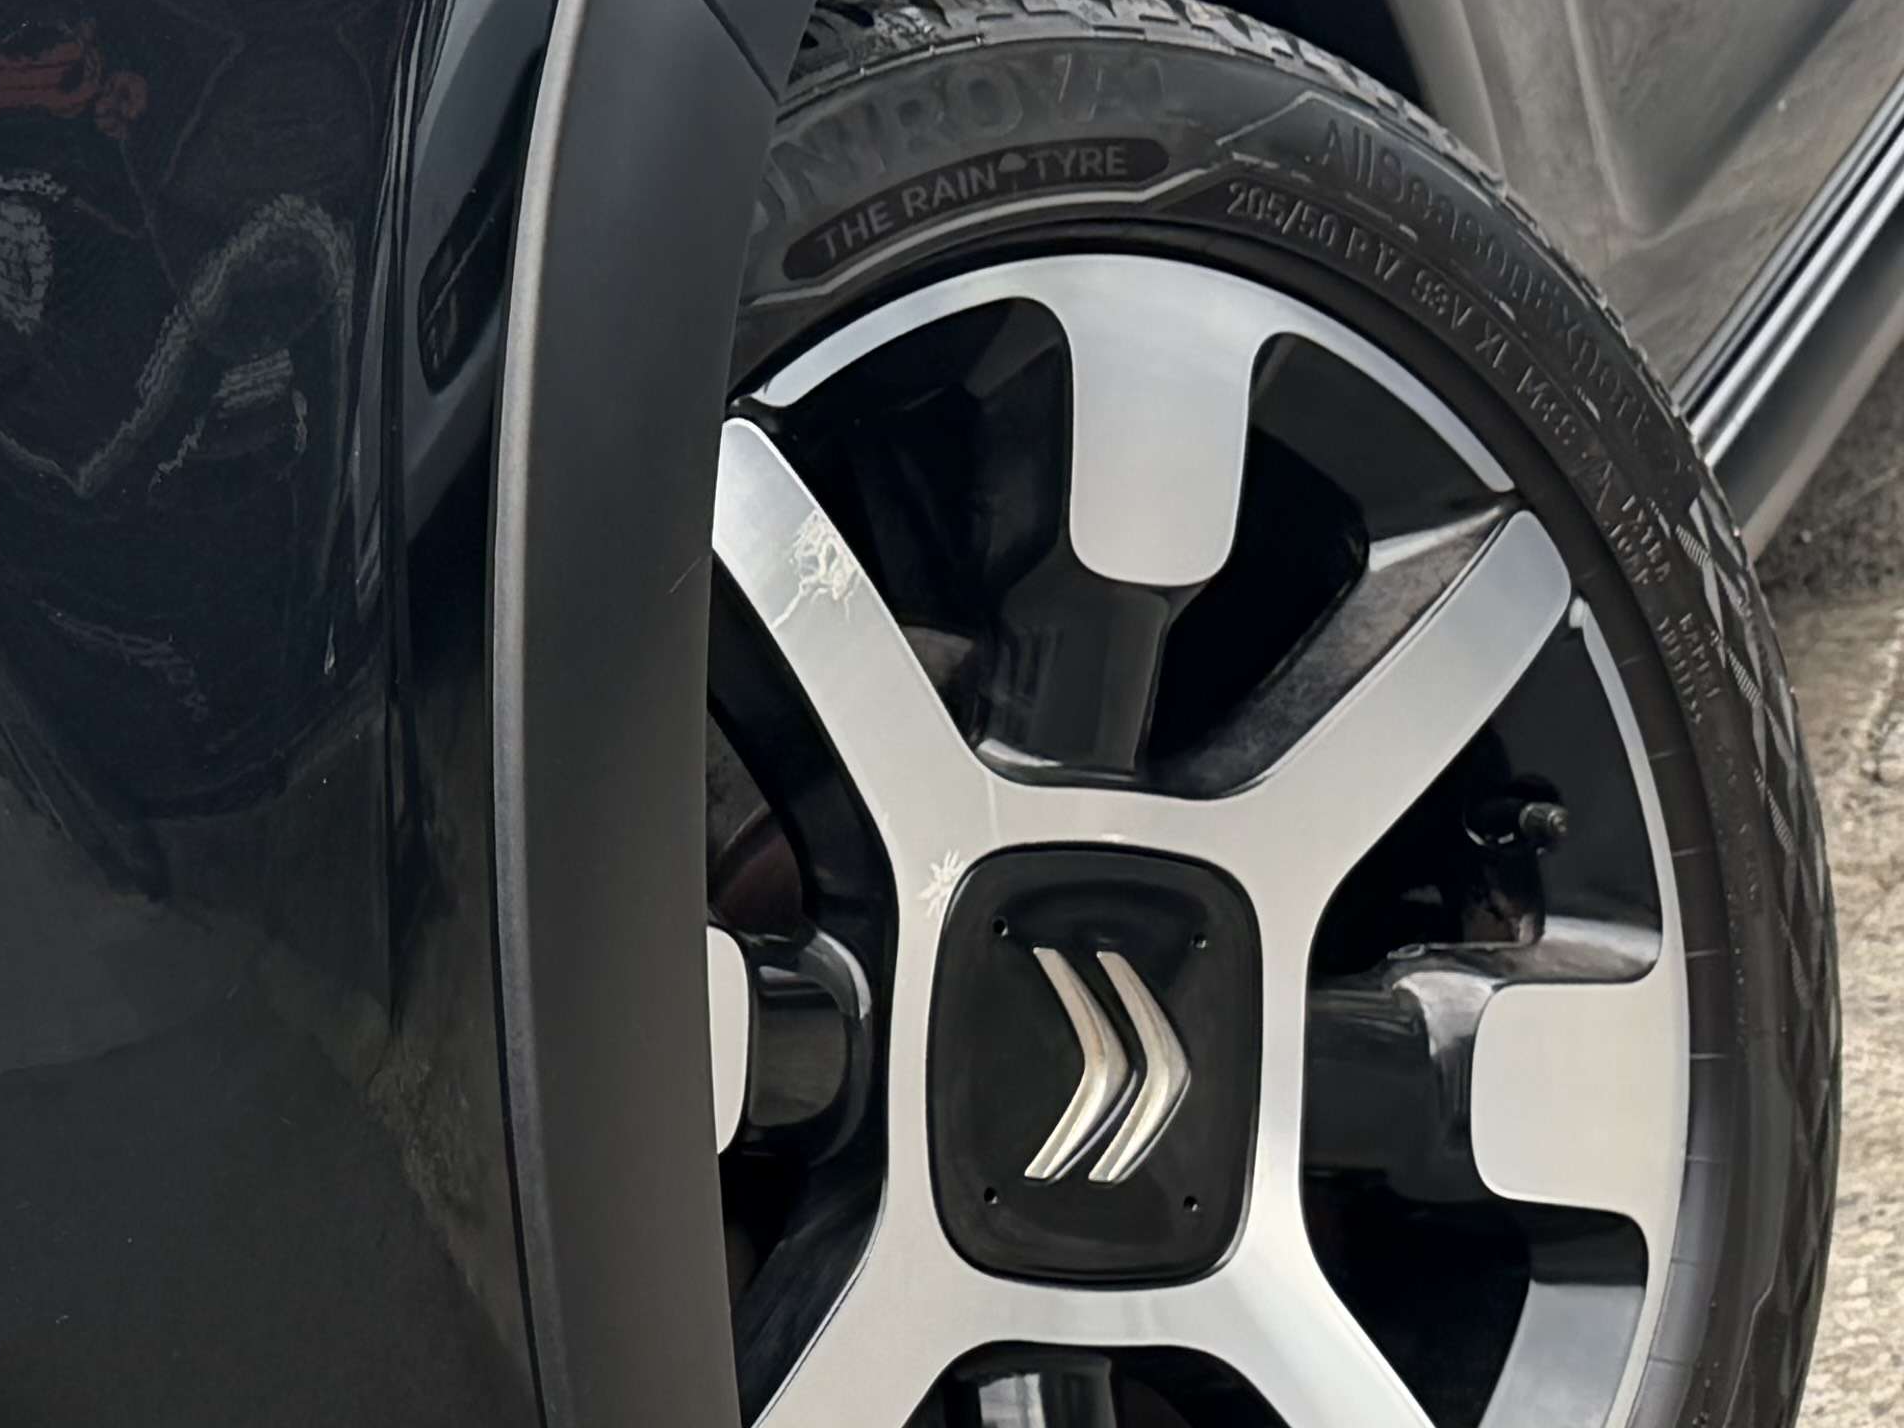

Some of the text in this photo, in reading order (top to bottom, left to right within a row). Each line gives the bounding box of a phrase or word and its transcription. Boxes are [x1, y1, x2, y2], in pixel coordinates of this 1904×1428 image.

[813, 145, 1130, 262] THE RAIN TYRE
